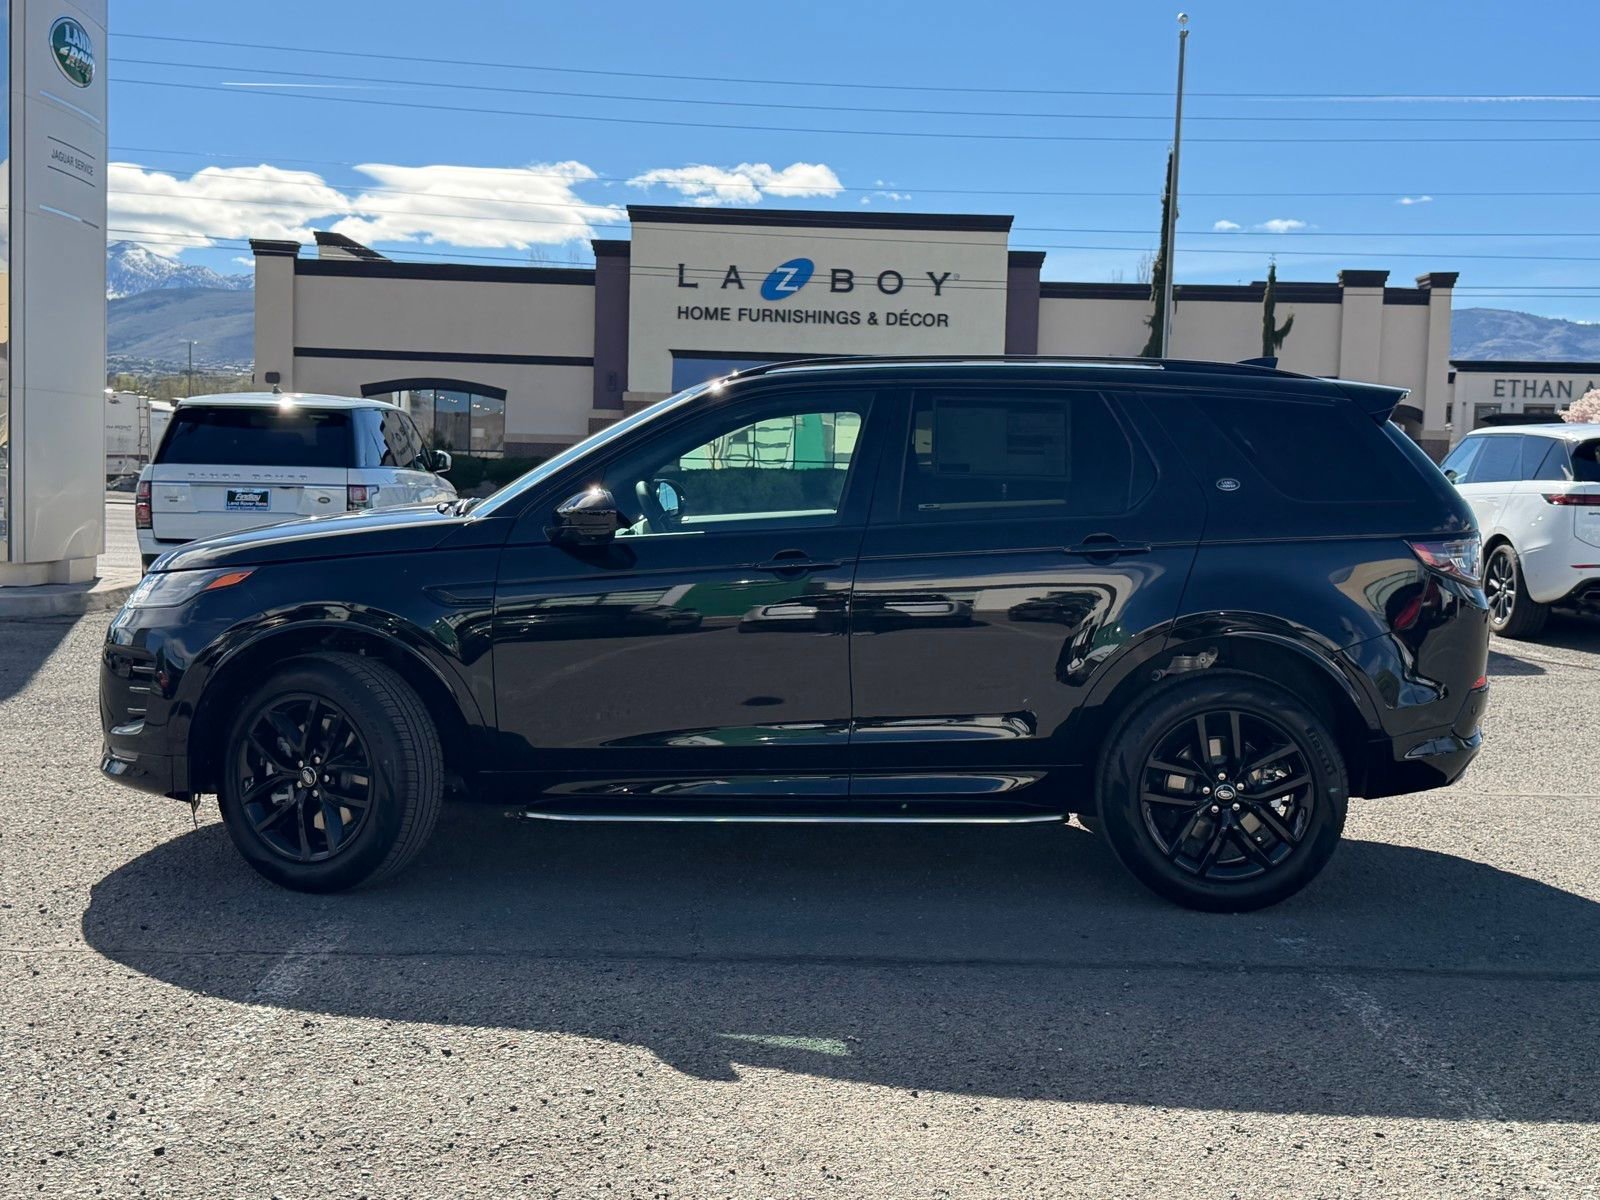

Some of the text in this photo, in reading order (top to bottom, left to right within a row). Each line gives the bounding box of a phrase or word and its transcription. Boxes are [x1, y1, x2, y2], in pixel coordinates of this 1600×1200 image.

[677, 306, 949, 328] HOME FURNISHINGS & DÉCOR
[1493, 379, 1573, 398] ETHAN
